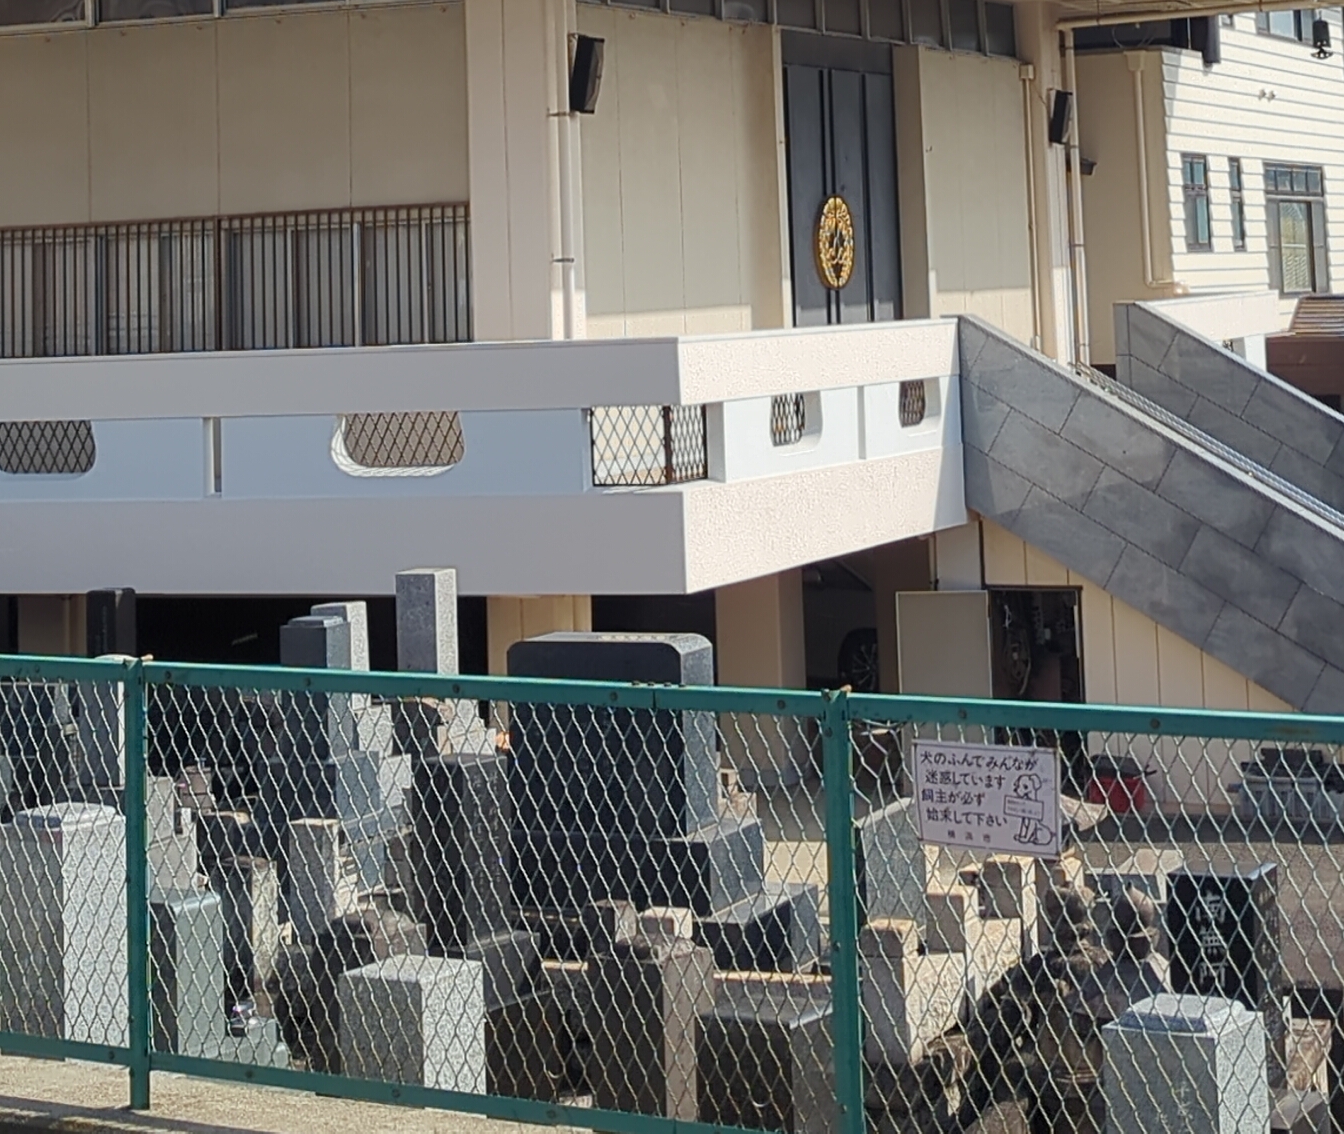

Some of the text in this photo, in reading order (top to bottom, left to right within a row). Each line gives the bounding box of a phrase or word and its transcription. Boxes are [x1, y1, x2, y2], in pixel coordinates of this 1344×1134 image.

[920, 751, 1038, 771] 犬のふんでみんなが
[925, 769, 1006, 790] 迷惑しています
[921, 788, 986, 807] 飼主が必ず
[926, 807, 1007, 826] 始末して下さい
